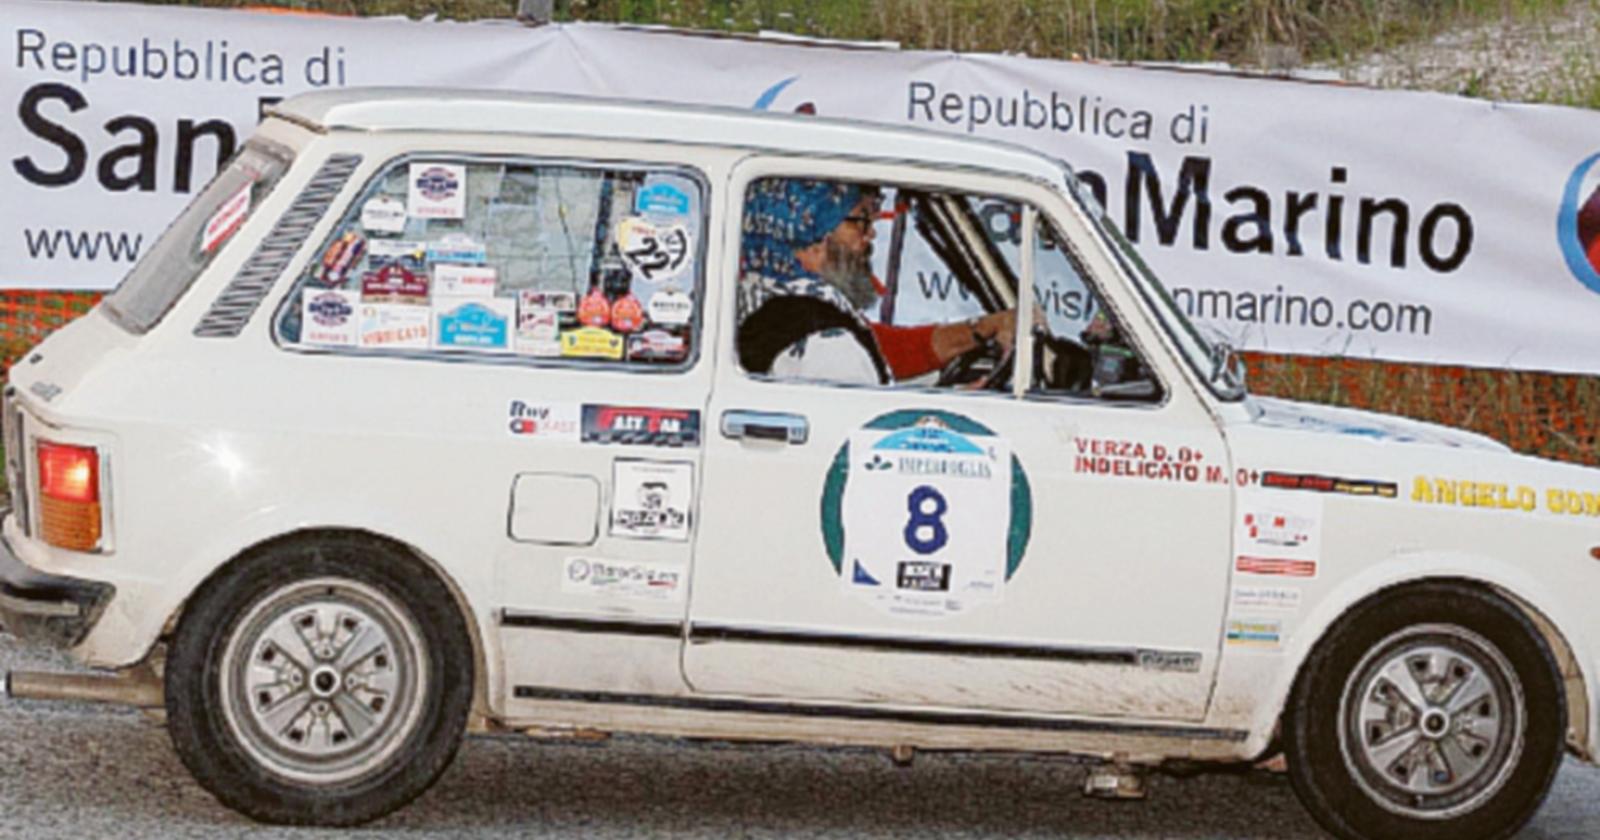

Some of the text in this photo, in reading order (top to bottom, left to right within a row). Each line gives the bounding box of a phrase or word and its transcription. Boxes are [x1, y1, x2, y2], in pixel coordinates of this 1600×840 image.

[16, 29, 347, 87] Repubblica di
[908, 82, 1209, 145] Repubblica di
[1074, 437, 1146, 459] VERZA
[1153, 444, 1173, 462] D.
[1074, 456, 1199, 483] INDELICATO
[1206, 465, 1229, 484] M.
[1410, 474, 1537, 513] ANGELO
[904, 485, 950, 555] 8
